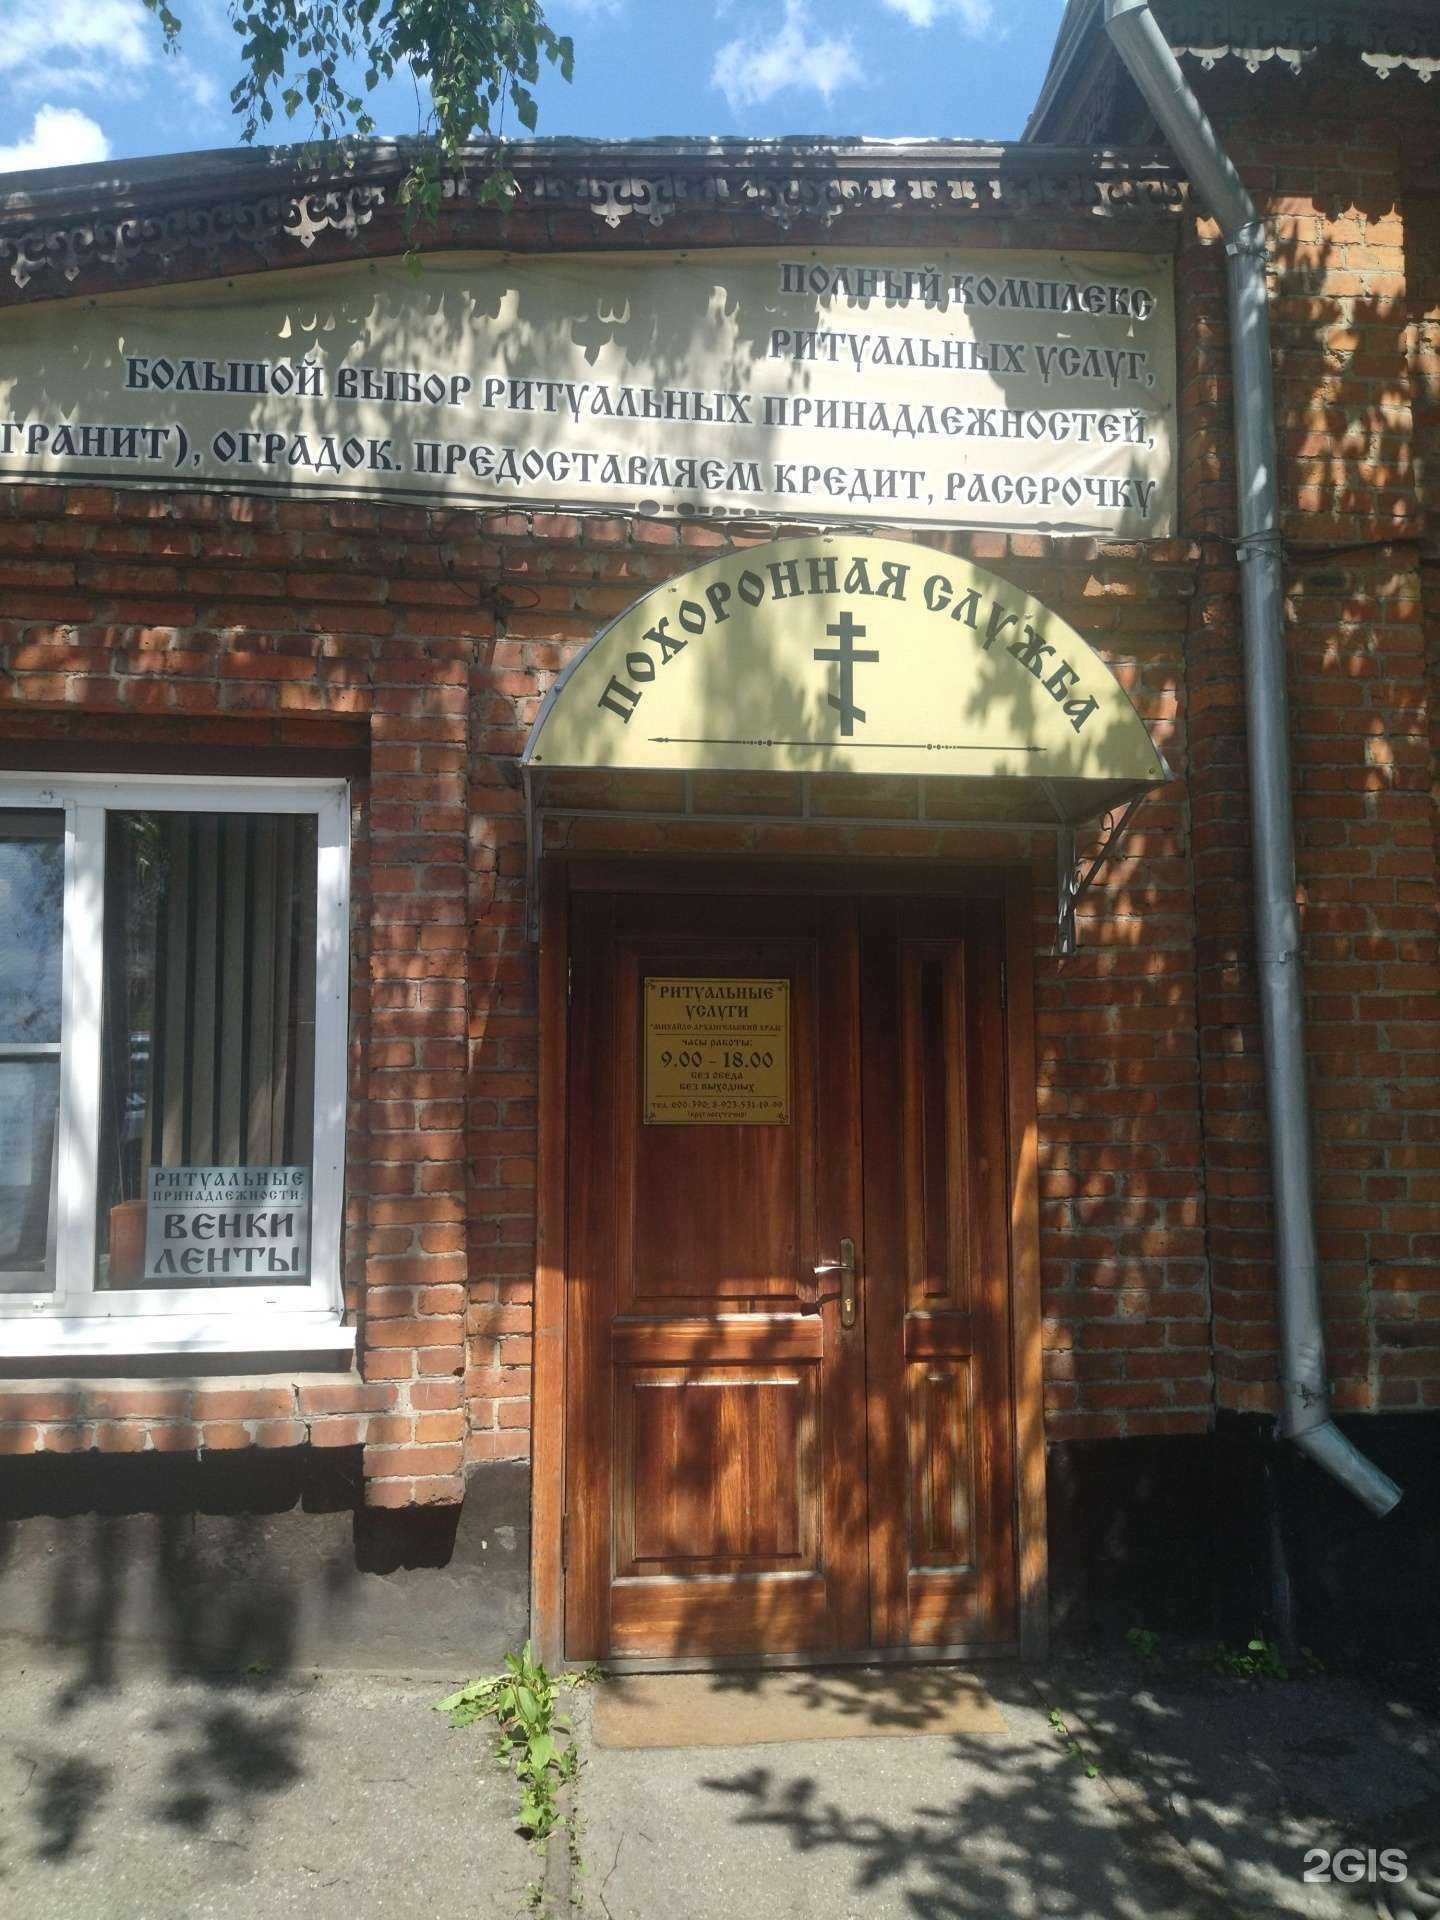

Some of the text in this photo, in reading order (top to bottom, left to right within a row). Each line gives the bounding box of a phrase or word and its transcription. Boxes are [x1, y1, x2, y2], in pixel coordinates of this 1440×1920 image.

[781, 263, 1153, 317] ПОЛНЫЙ КОМПЛЕКС
[770, 329, 1155, 387] РИТУАЛЬНЫХ УСЛУГ,
[126, 357, 1155, 448] БОЛЬШОЙ ВЫБОР РИТУАЛЬНЫХ ПРИНАДЛЕЖНОСТЕЙ,
[0, 423, 1155, 518] ГРАНИТ), ОГРАДОК. ПРЕДОСТАВЛЯЕМ КРЕДИТ, РАССРОЧКУ
[597, 556, 1100, 733] ПОХОРОННАЯ СЛУЖБА
[660, 986, 775, 1000] РИТУАЛЬНЫЕ
[686, 1005, 749, 1020] УСЛУГИ
[661, 1051, 702, 1068] 9.00
[724, 1051, 774, 1068] 18.00
[679, 1083, 755, 1093] БЕЗ ВЫХОДНЫХ
[691, 1071, 744, 1081] БЕЗ ОБЕДА
[154, 1172, 304, 1189] РИТУАЛЬНЫЕ
[164, 1212, 294, 1240] ВЕНКИ
[153, 1246, 300, 1275] ЛЕНТЫ
